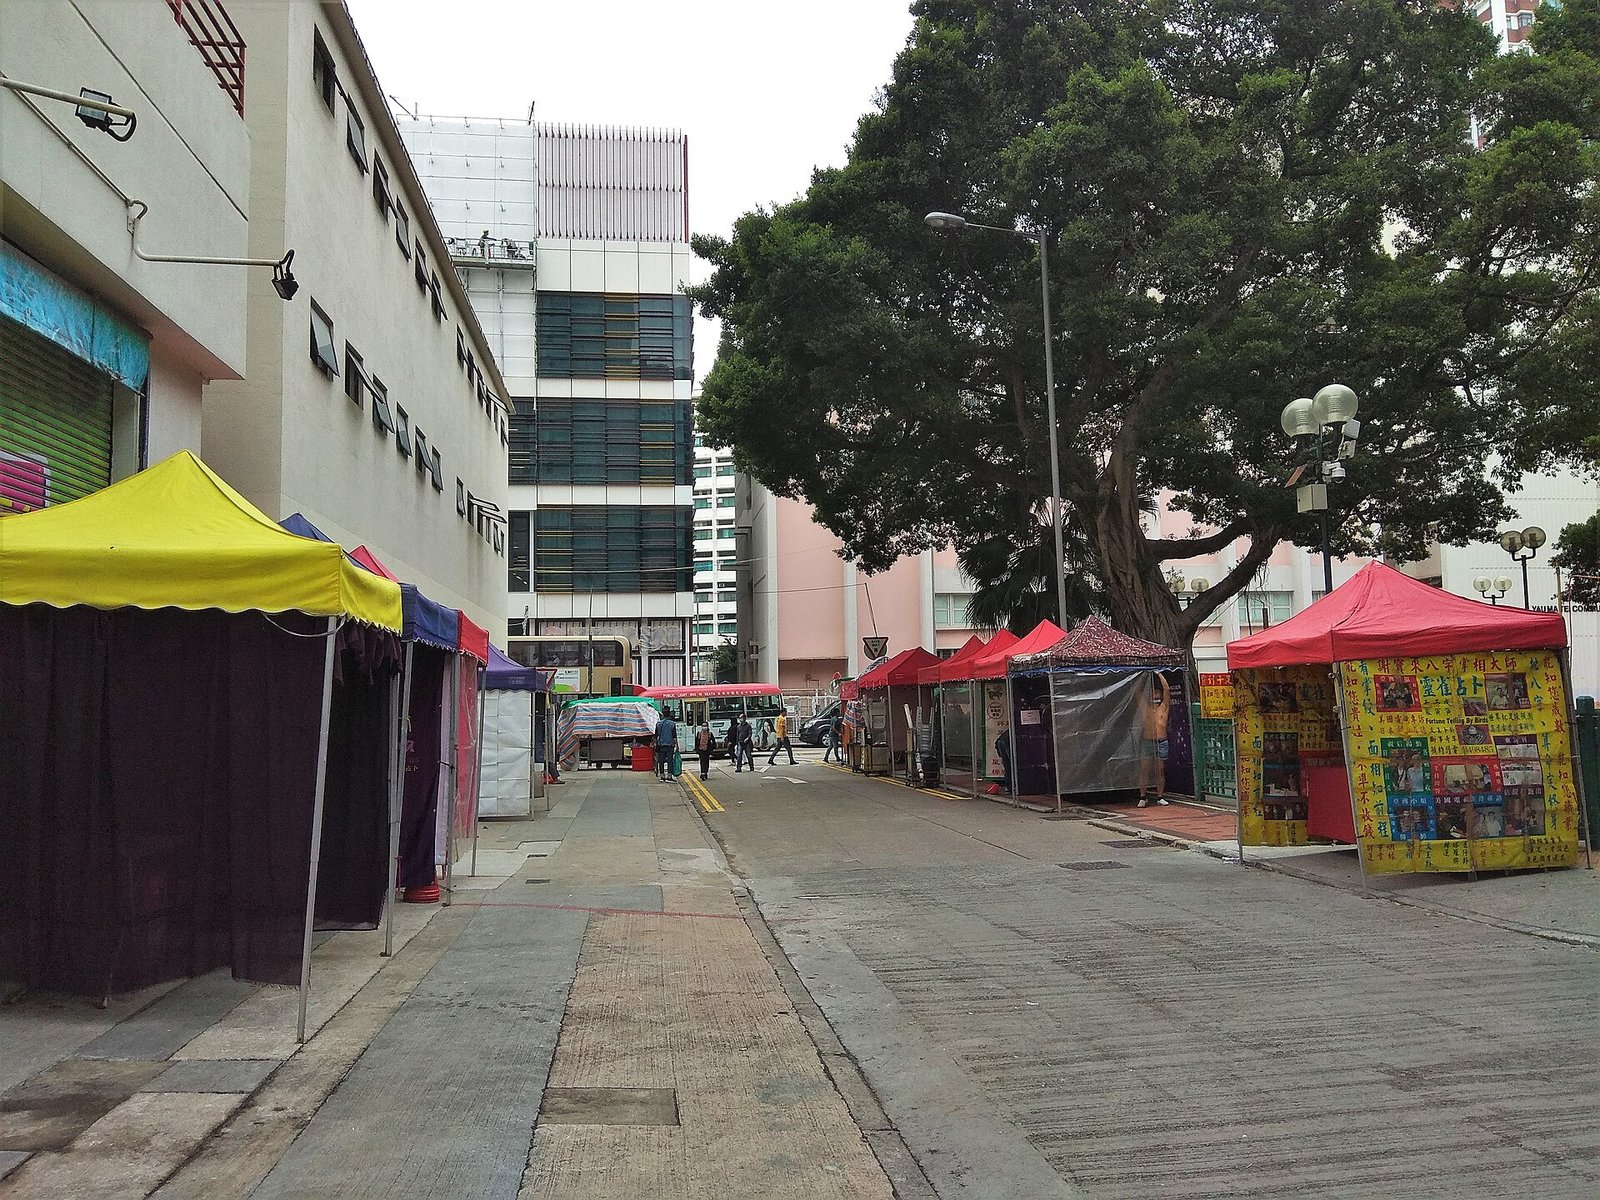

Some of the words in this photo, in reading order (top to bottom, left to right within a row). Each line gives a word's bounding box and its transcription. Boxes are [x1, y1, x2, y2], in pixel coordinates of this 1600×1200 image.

[1419, 674, 1484, 698] 靈雀占卜
[1425, 717, 1445, 725] Fortune
[1446, 717, 1465, 726] Telling
[1465, 717, 1474, 726] By
[1474, 716, 1489, 724] Birds
